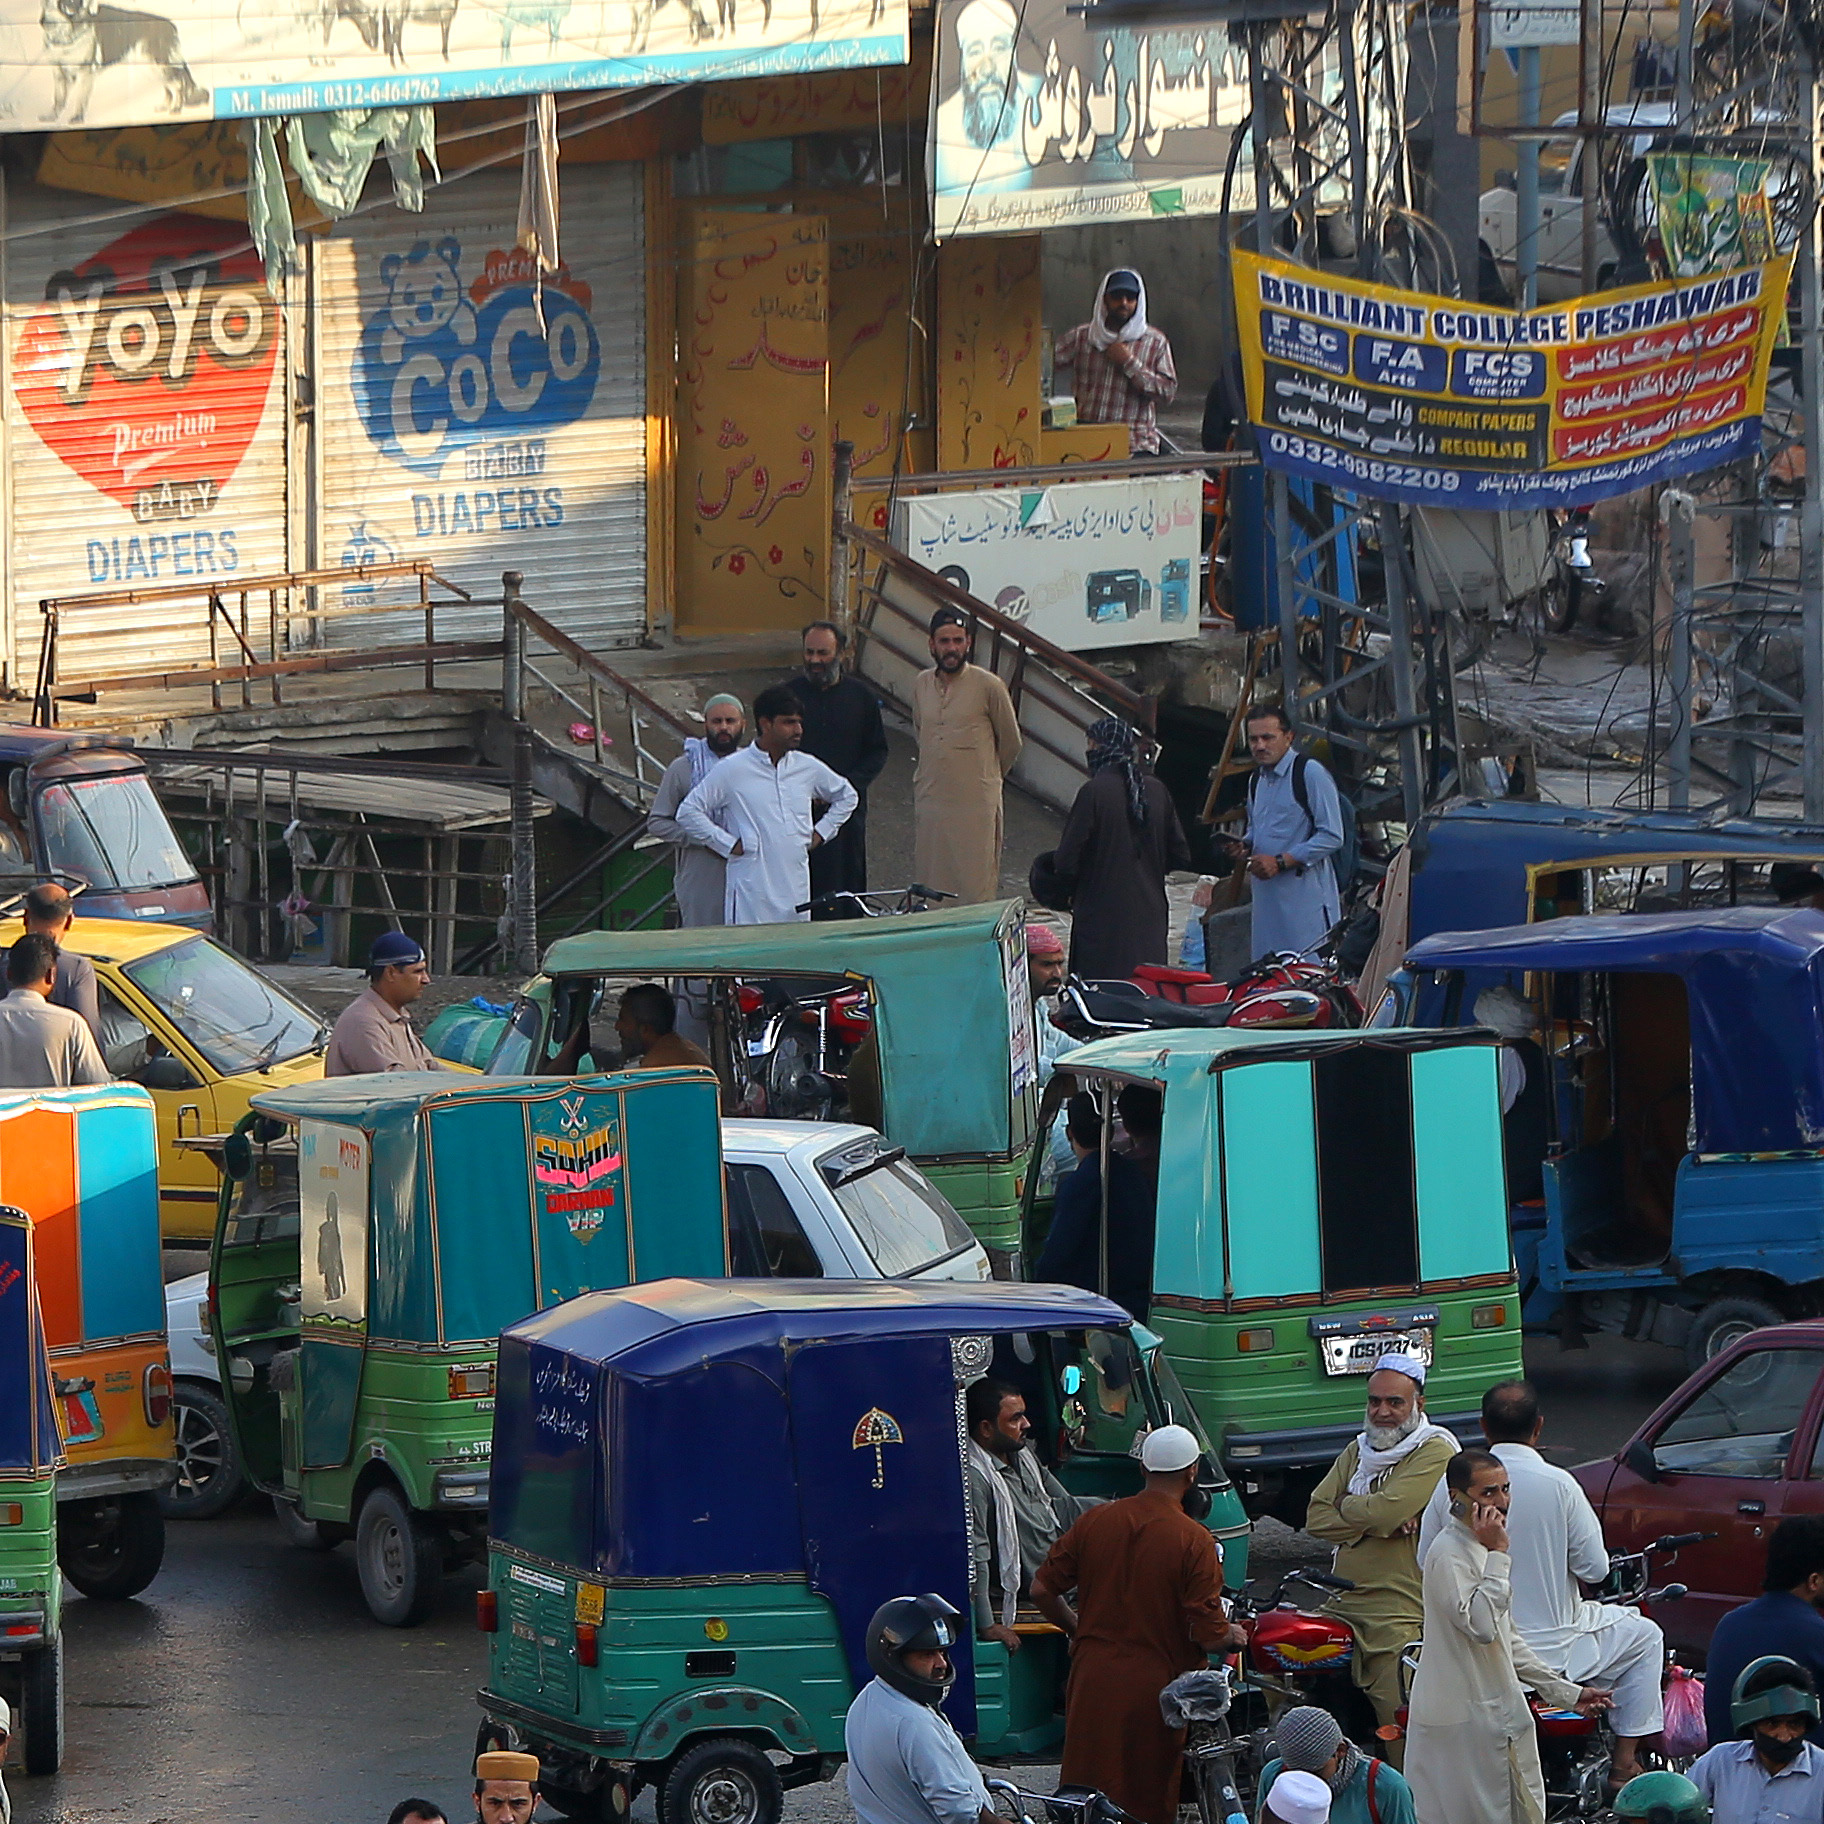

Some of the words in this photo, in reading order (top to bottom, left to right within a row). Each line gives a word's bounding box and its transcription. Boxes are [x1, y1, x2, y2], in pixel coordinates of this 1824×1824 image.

[323, 77, 441, 107] 0312-6464762
[1257, 269, 1428, 341] BRILLIANT
[1430, 308, 1571, 348] COLLEGE
[1575, 269, 1764, 342] PESHAWAR
[1370, 340, 1425, 372] F.A
[1464, 351, 1534, 378] FCS
[1377, 370, 1417, 388] Arts
[1368, 400, 1413, 427] والے
[1417, 406, 1480, 431] COMPART
[1481, 407, 1537, 432] PAPERS
[105, 411, 217, 468] Premium
[1370, 424, 1436, 454] داخلے
[1439, 438, 1528, 459] REGULAR
[465, 440, 546, 481] BABY
[1269, 432, 1461, 492] 0332-9882209
[138, 480, 212, 519] BABY
[411, 487, 565, 537] DIAPERS
[1155, 499, 1196, 536] خان
[920, 514, 957, 557] شاپ
[86, 529, 240, 583] DIAPERS
[534, 1127, 622, 1189] SAHIL
